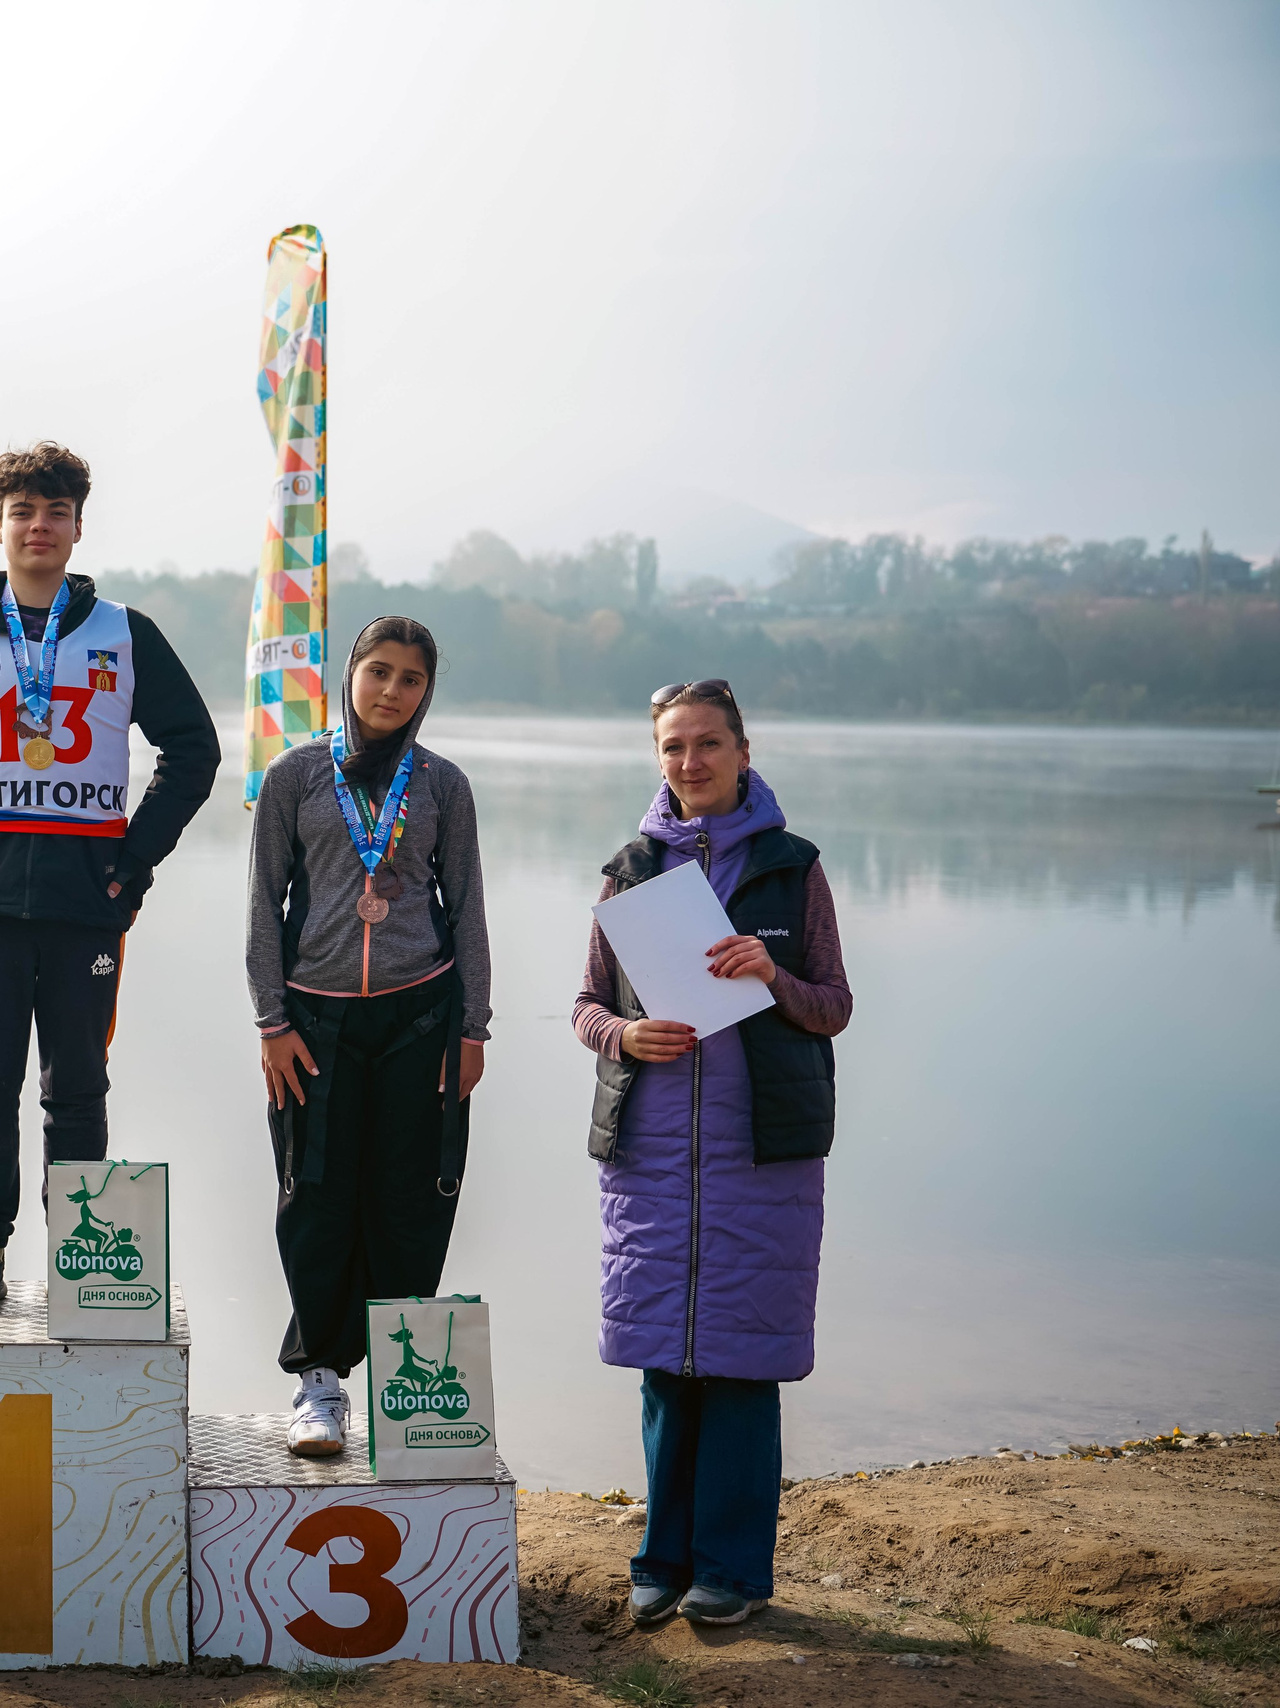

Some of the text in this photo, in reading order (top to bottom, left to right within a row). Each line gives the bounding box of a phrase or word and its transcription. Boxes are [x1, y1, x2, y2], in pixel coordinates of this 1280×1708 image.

[14, 643, 32, 690] СТАВРОПОЛЬЕ
[41, 646, 54, 692] СТАВРОПОЛЬЕ
[342, 800, 366, 846] СТАВРОПОЛЬЕ
[375, 800, 396, 845] СТАВРОПОЛЬЕ
[367, 900, 378, 912] 3
[757, 928, 789, 938] AlphaPet
[92, 964, 114, 976] Kappa
[59, 1249, 141, 1271] bionova
[82, 1291, 152, 1302] ДНЯ ОСНОВА
[384, 1389, 468, 1411] bionova
[409, 1430, 481, 1442] ДНЯ ОСНОВА
[284, 1505, 408, 1658] 3
